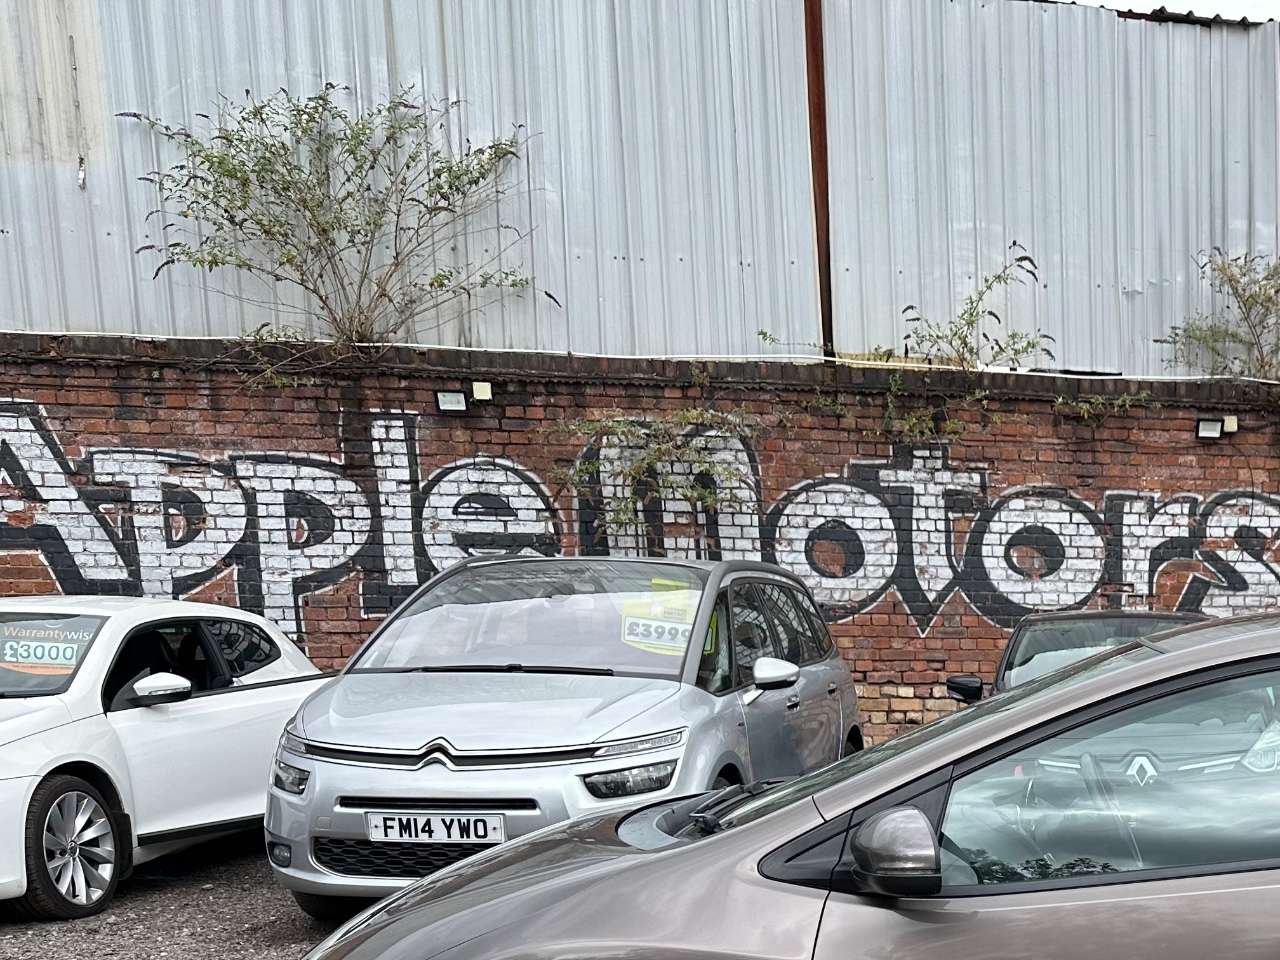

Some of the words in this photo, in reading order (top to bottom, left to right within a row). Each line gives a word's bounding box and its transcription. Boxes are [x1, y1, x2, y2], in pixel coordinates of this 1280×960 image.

[0, 398, 566, 650] Apple
[626, 621, 689, 640] £3999
[3, 641, 75, 661] £3000
[382, 817, 434, 838] FM14
[441, 818, 488, 839] YWO
